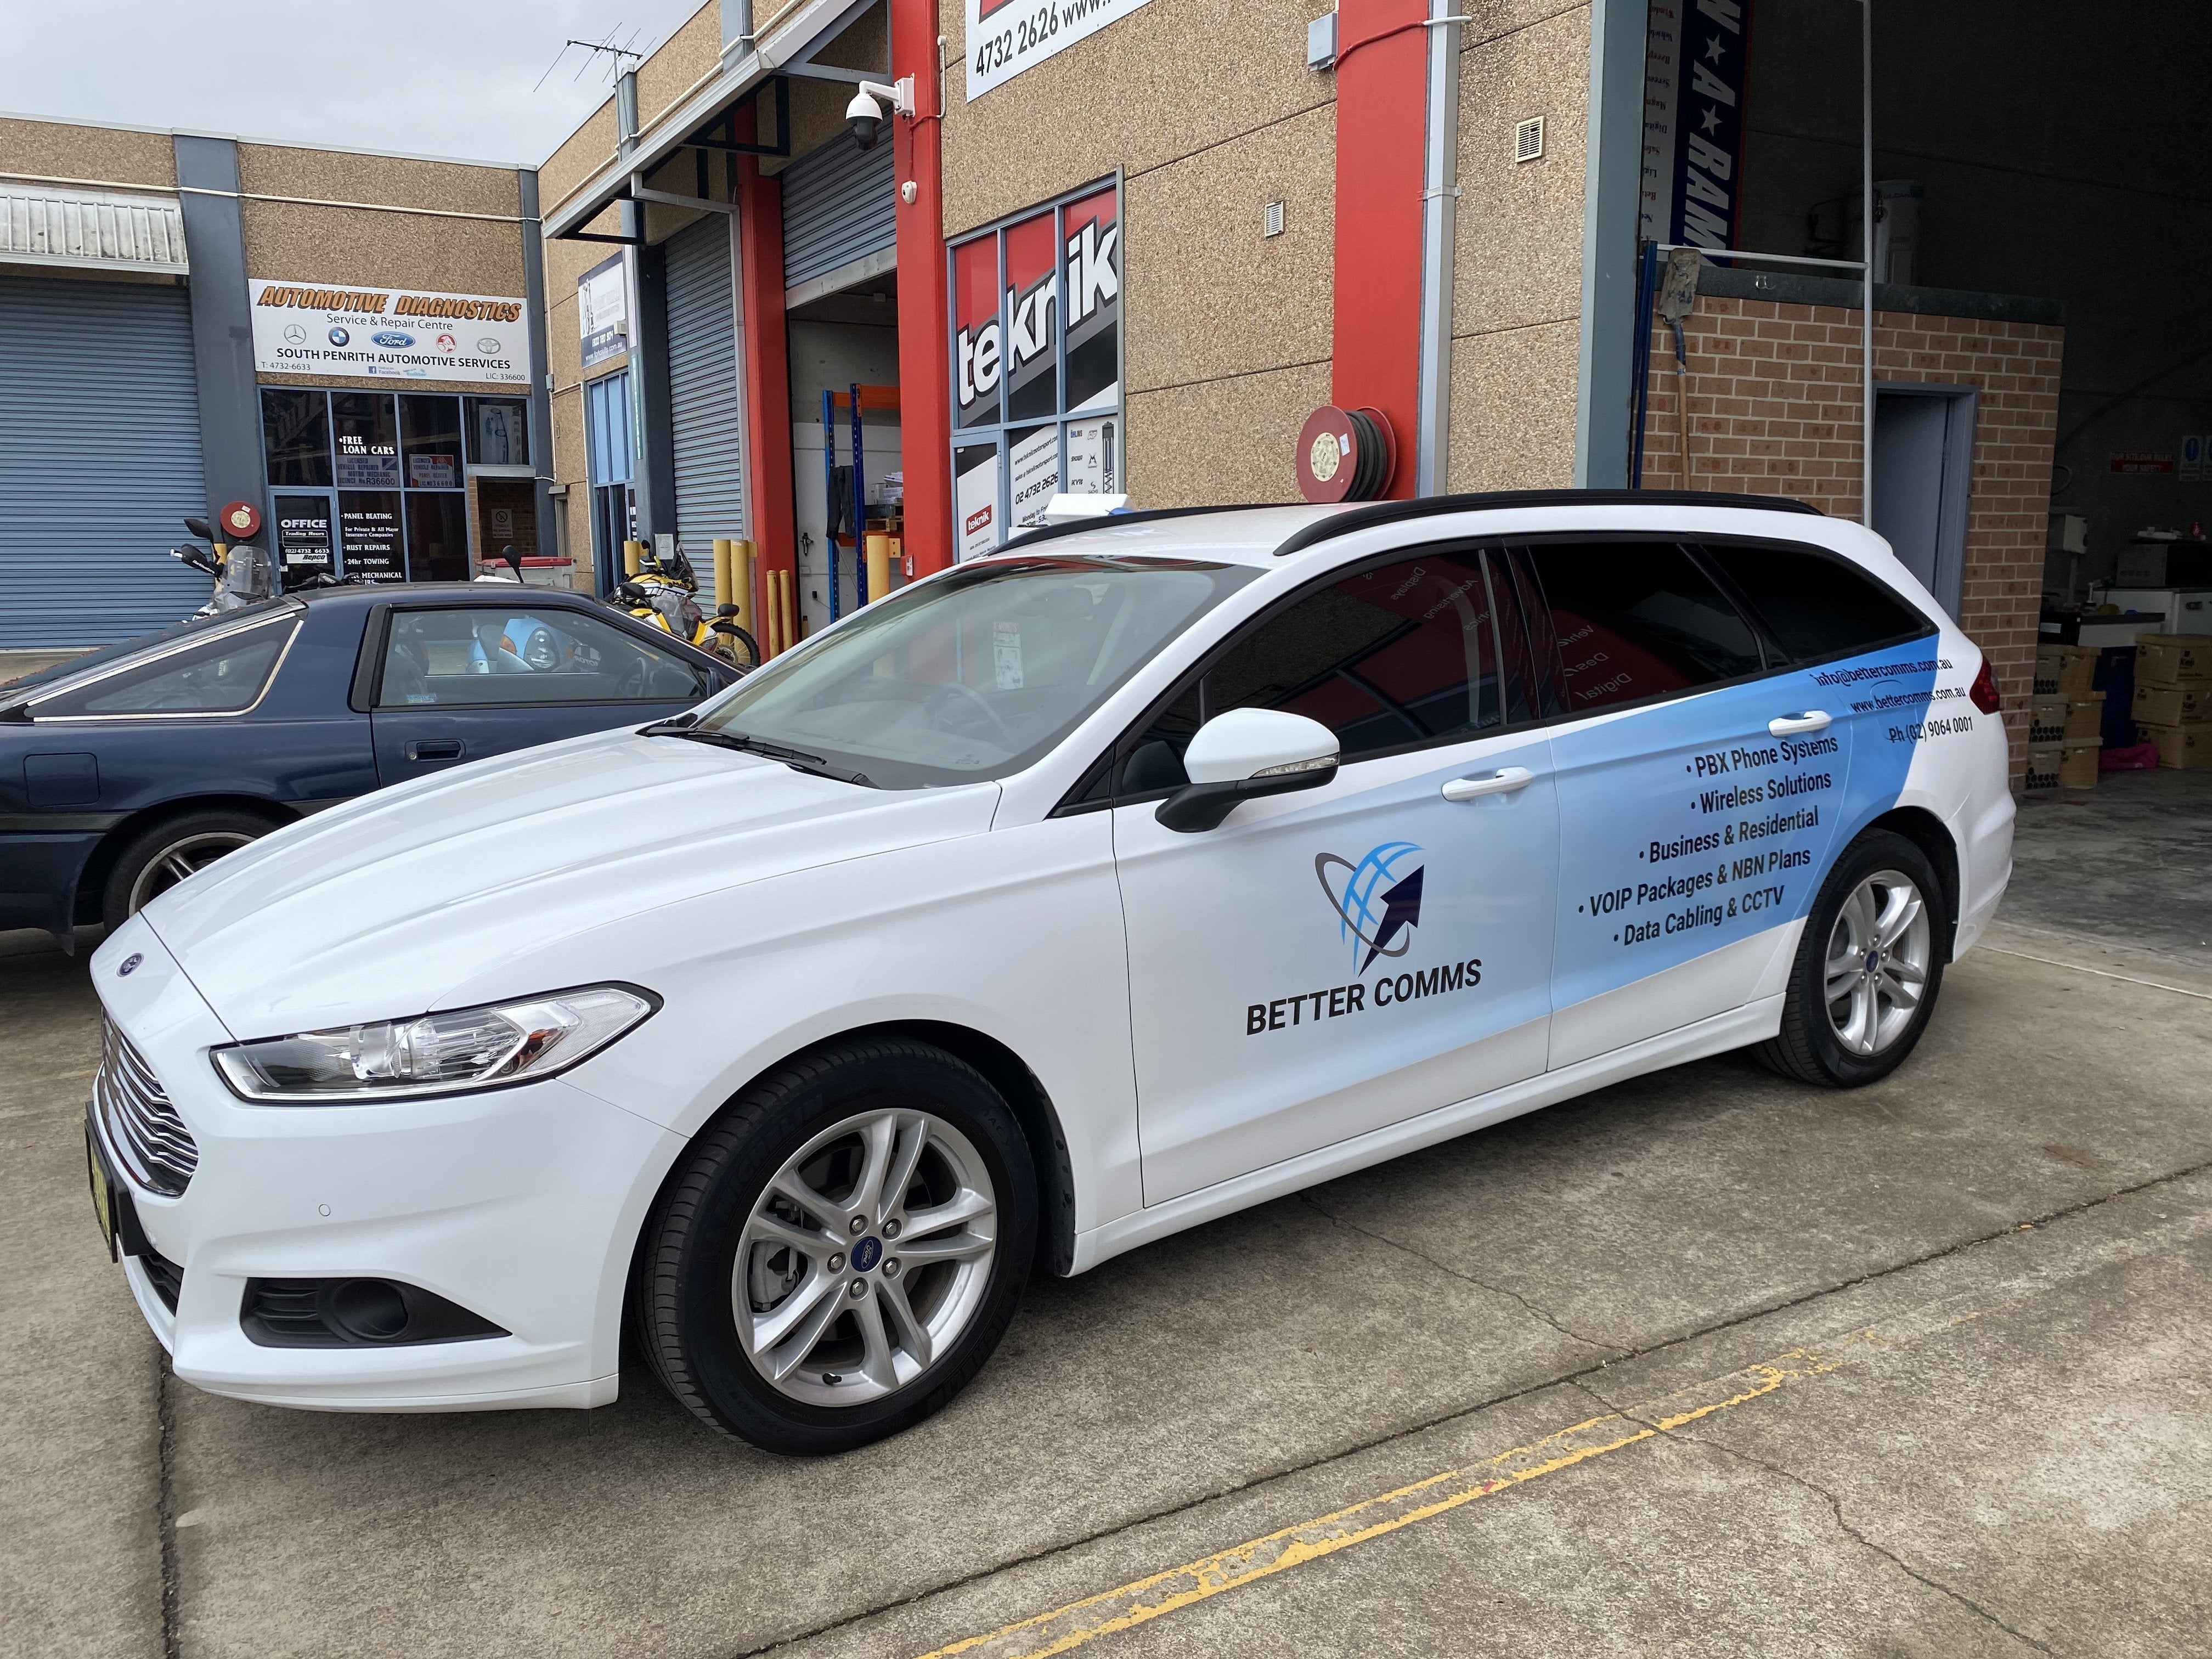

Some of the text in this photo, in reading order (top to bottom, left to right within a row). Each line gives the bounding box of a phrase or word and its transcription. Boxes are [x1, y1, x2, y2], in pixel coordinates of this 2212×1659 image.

[976, 30, 1013, 77] 4732
[1018, 2, 1058, 55] 2626
[1692, 59, 1735, 107] A
[1684, 132, 1731, 267] RAM
[257, 286, 522, 322] AUTOMOTIVE DIAGNOSTICS
[958, 222, 1118, 405] teknik
[327, 314, 453, 330] Service & Repair Centre
[379, 334, 407, 346] Ford
[269, 362, 311, 371] 4732-6633
[277, 348, 510, 369] SOUTH PENRITH AUTOMOTIVE SERVICES
[342, 436, 363, 445] FREE
[343, 445, 394, 455] LOAN CARS
[1015, 472, 1058, 505] 02 4732 2626
[281, 519, 327, 528] OFFICE
[968, 511, 989, 531] teknik
[1023, 512, 1035, 523] Monday
[1810, 658, 1953, 687] info@bettercomms.com.au
[1850, 687, 1966, 713] www.bettercomms.com.au
[1888, 716, 1973, 744] Ph (02) 9064 0001
[1695, 736, 1838, 777] PBX Phone Systems
[1700, 771, 1832, 814] Wireless Solutions
[1650, 805, 1819, 864] Business & Residential
[1590, 849, 1811, 917] VOIP Packages & NBN Plans
[1624, 885, 1785, 946] Data Cabling & CCTV
[1246, 958, 1482, 1036] BETTER COMMS
[863, 1245, 872, 1264] Ford
